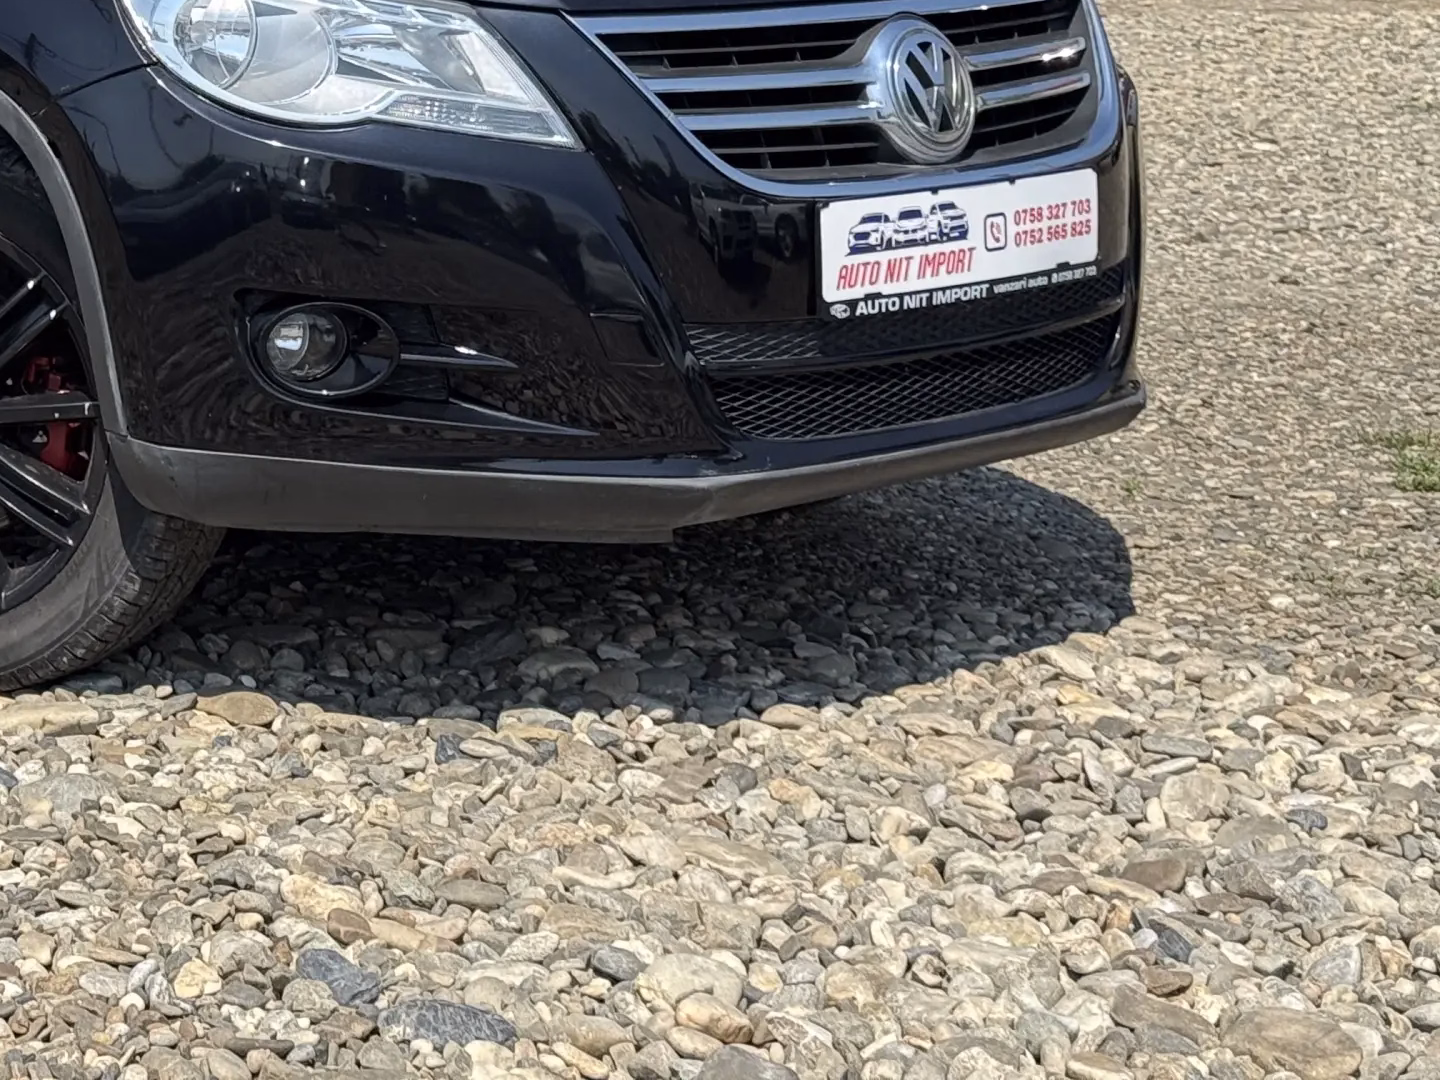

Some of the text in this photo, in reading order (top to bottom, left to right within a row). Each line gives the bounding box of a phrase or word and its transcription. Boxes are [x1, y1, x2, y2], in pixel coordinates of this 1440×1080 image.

[1014, 198, 1091, 226] 0758 327 703
[1014, 219, 1092, 248] 0752 565 825
[836, 247, 976, 291] AUTO NIT IMPORT
[855, 296, 900, 316] AUTO
[903, 292, 930, 310] NIT
[932, 284, 990, 306] IMPORT
